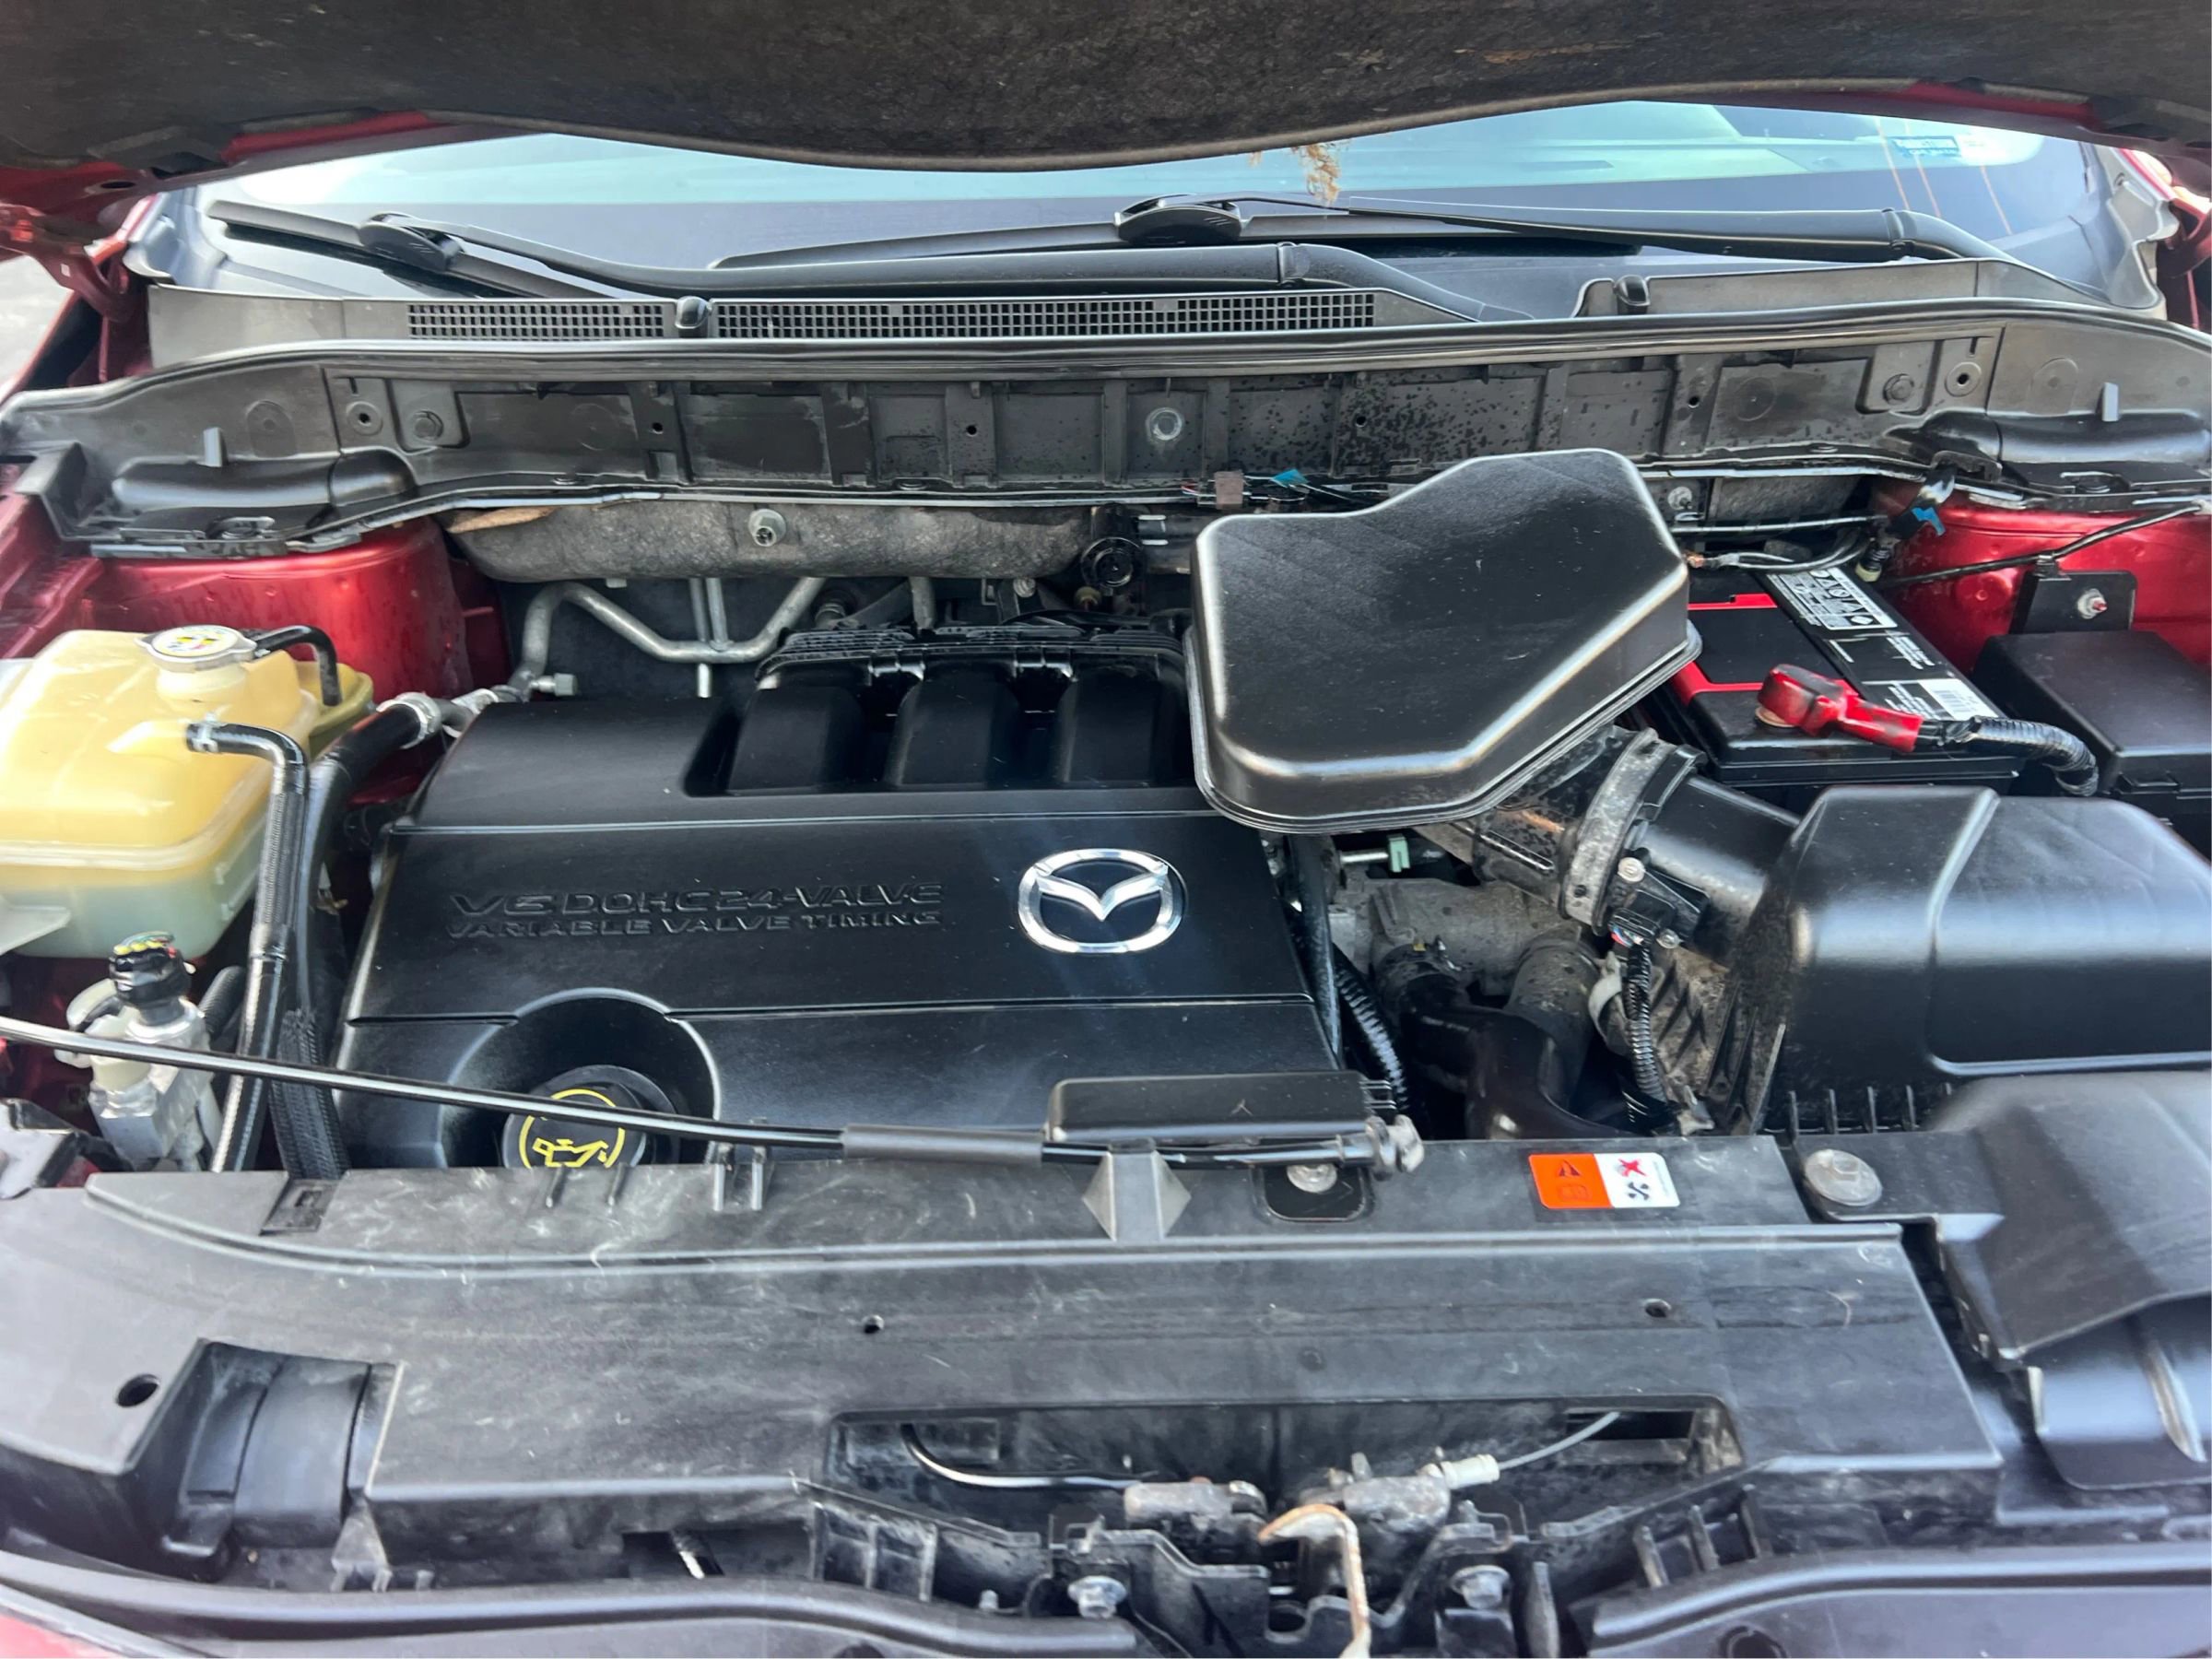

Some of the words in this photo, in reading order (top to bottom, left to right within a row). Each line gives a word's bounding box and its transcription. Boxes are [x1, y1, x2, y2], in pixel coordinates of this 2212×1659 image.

[449, 892, 553, 916] V6
[561, 889, 712, 915] DOHC
[715, 882, 942, 911] 24-VALVE
[445, 920, 652, 939] VARIABLE
[662, 916, 791, 935] VALVE
[800, 911, 941, 930] TIMING
